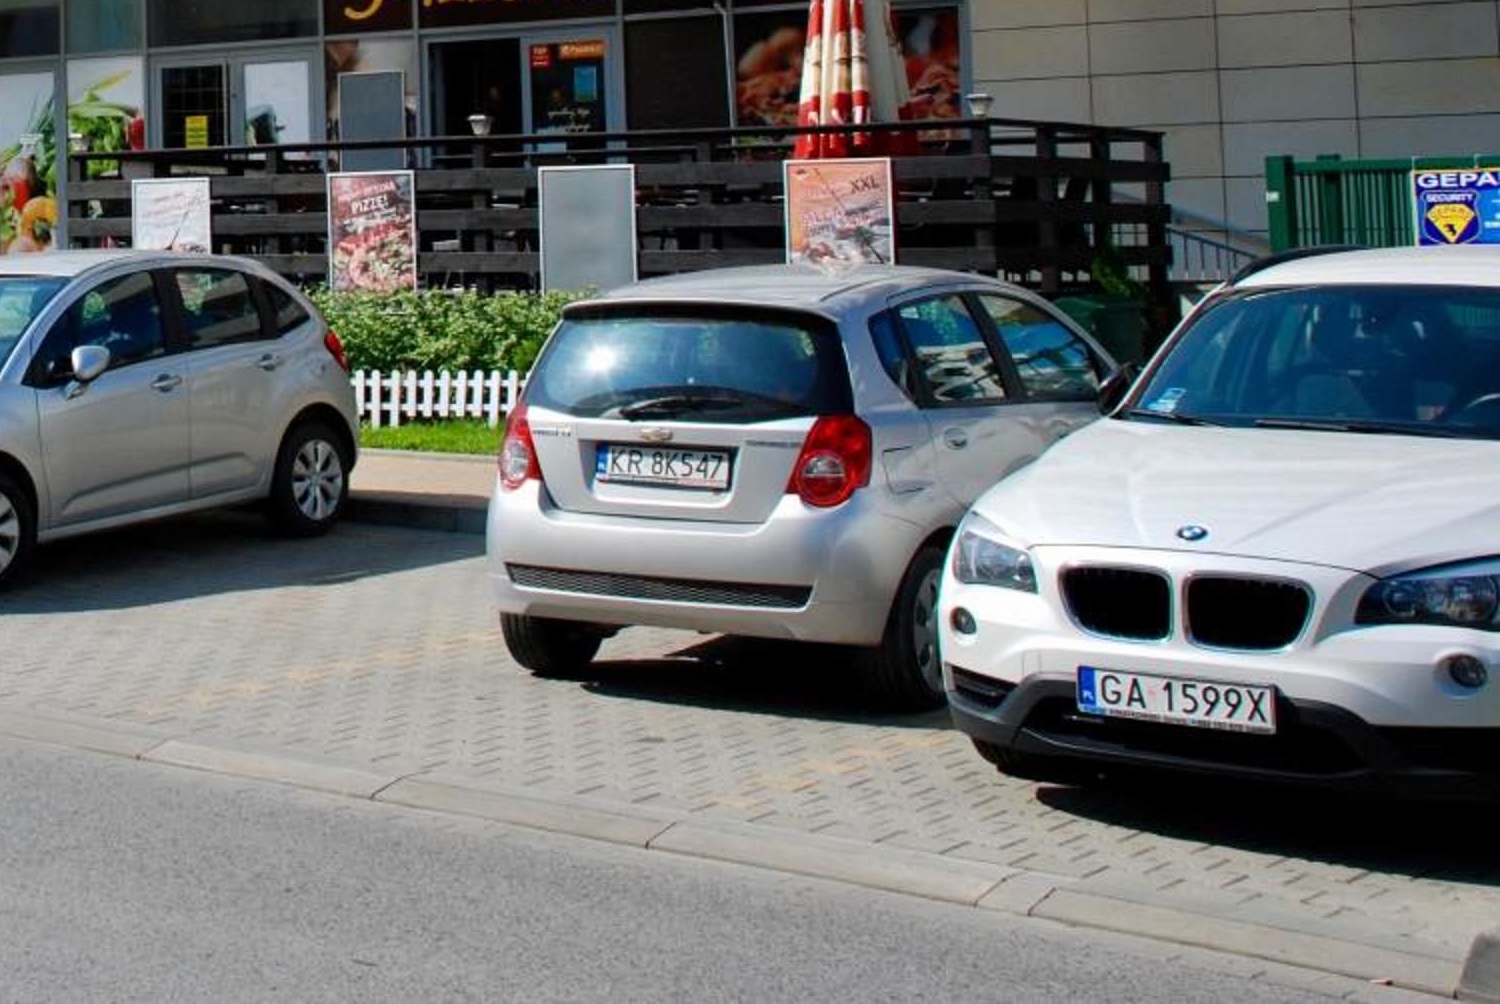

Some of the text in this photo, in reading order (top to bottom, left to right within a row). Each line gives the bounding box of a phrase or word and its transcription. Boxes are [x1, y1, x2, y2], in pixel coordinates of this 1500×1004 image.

[1417, 171, 1500, 188] GEPA
[1425, 193, 1474, 203] SECURITY
[610, 449, 723, 480] KR 8K547
[1100, 674, 1147, 709] GA
[1162, 681, 1267, 723] 1599X
